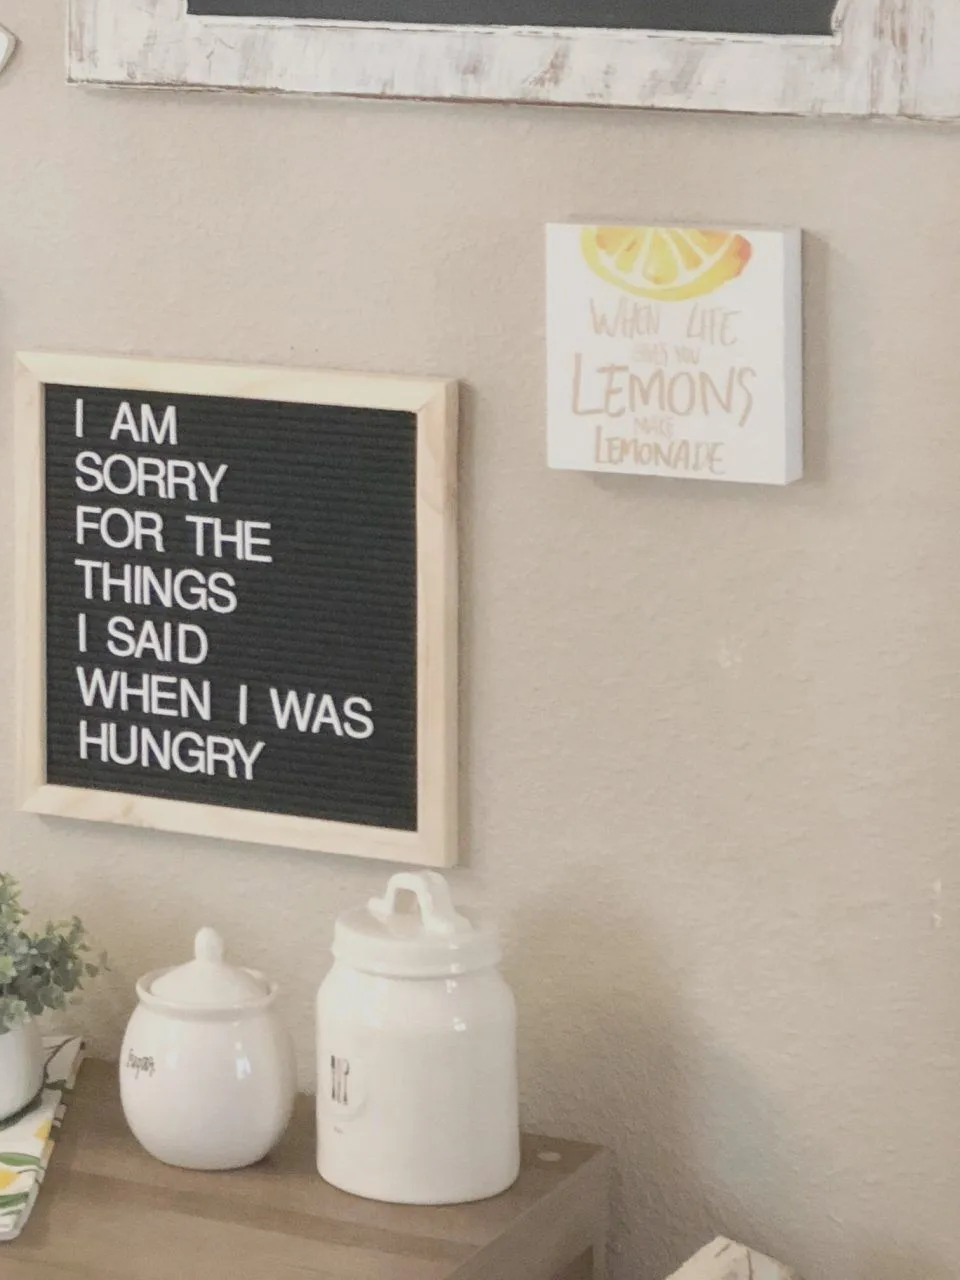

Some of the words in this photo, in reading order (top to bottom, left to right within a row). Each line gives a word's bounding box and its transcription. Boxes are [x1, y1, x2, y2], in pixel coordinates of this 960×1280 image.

[571, 352, 758, 428] LEMONS
[75, 398, 84, 438] I
[109, 401, 178, 446] AM
[595, 425, 727, 475] LEMONADE
[74, 451, 229, 503] SORRY
[76, 505, 166, 553] FOR
[185, 514, 273, 563] THE
[74, 558, 238, 614] THINGS
[77, 612, 87, 653] I
[106, 616, 209, 665] SAID
[75, 666, 211, 722] WHEN
[238, 684, 248, 726] I
[269, 687, 375, 740] WAS
[78, 720, 266, 781] HUNGRY
